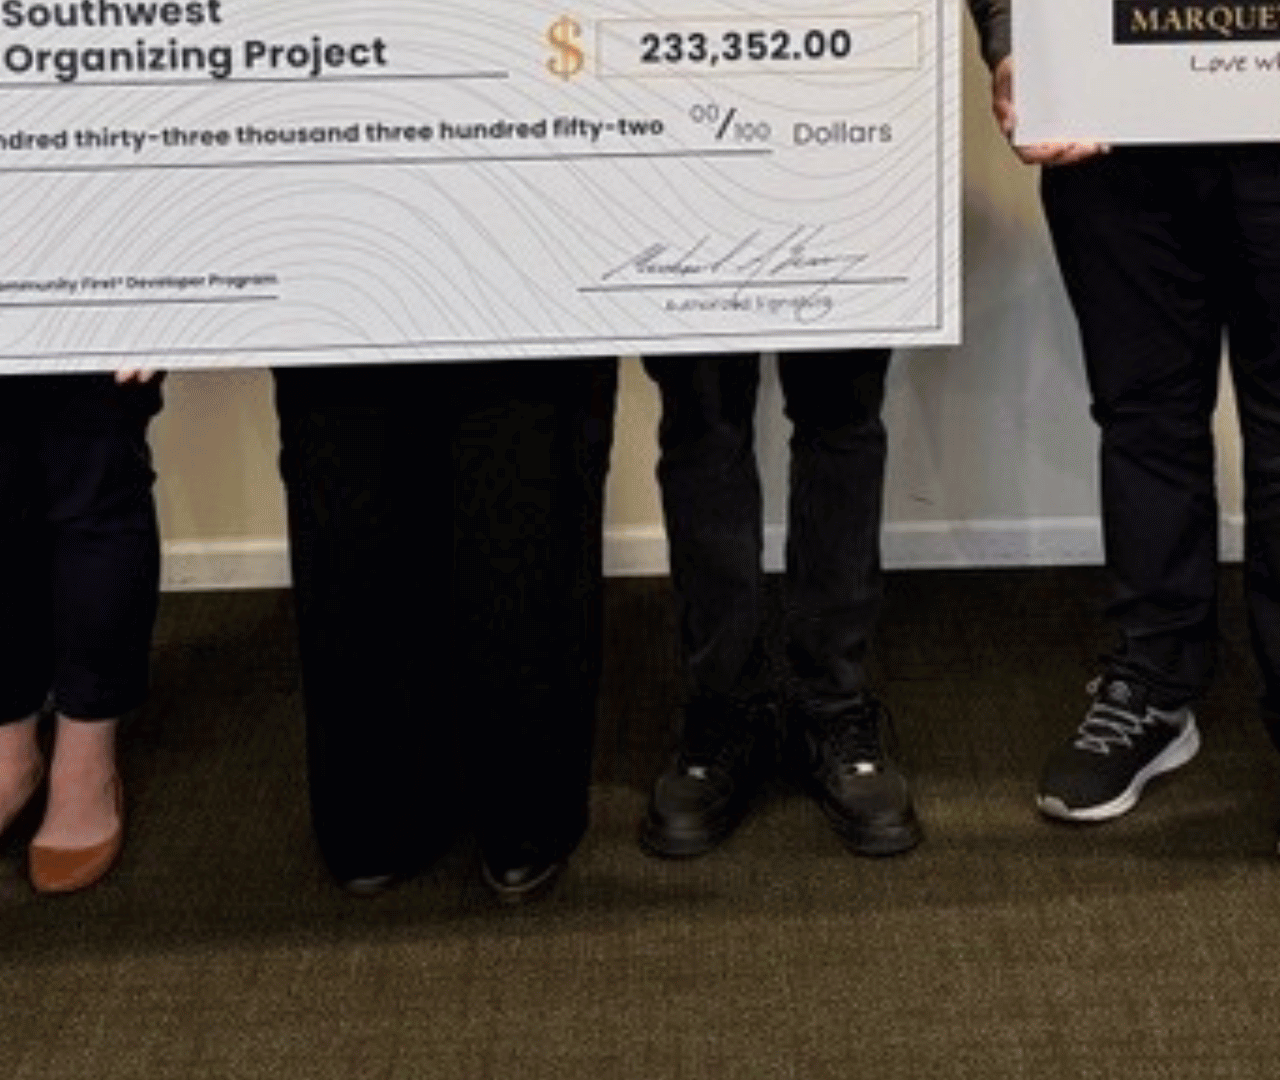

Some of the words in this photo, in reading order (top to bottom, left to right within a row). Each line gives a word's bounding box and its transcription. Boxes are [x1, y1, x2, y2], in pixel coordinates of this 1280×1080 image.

[4, 37, 233, 82] Organizing
[244, 35, 388, 78] Project
[543, 14, 585, 82] $
[640, 29, 852, 66] 233,352.00
[1190, 54, 1248, 74] Love
[74, 126, 230, 153] thirty-three
[236, 122, 360, 147] thousand
[365, 122, 434, 143] three
[439, 117, 547, 141] hundred
[553, 117, 665, 142] fifty-two
[792, 122, 893, 146] Dollars
[126, 274, 206, 291] Developer
